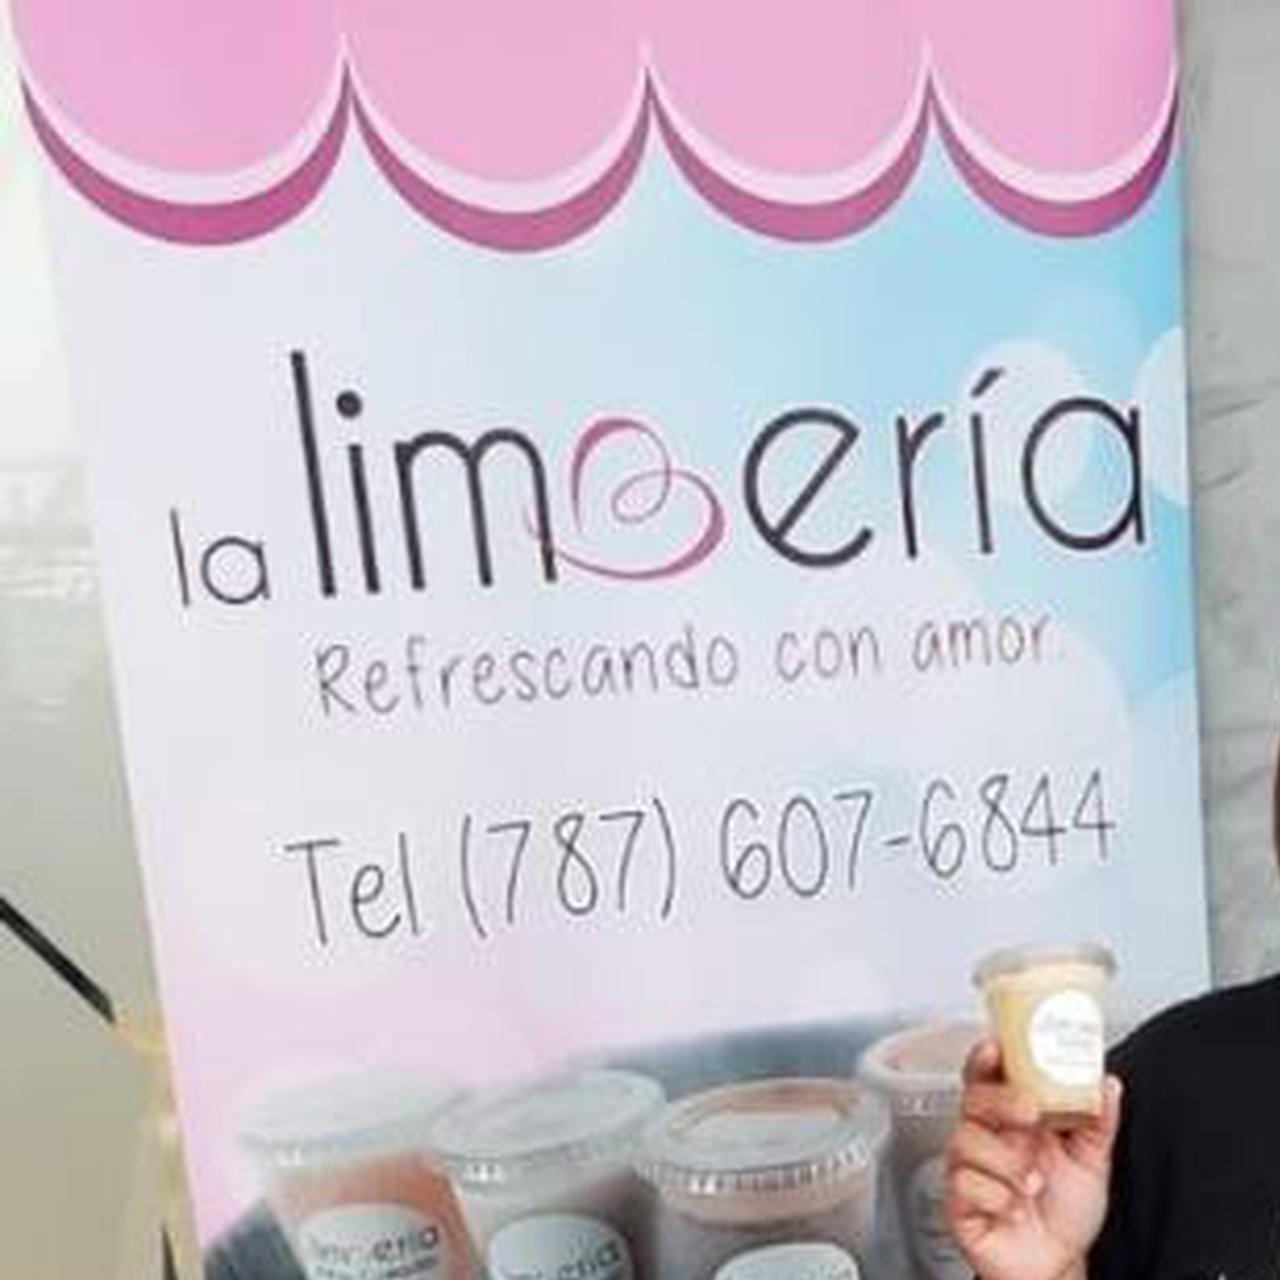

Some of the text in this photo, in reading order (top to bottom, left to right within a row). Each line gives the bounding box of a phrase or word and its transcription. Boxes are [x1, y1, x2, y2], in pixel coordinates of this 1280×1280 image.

[169, 508, 272, 608] la
[315, 624, 739, 718] Refrescando
[774, 621, 882, 684] con
[284, 768, 1118, 944] Tel (787) 607-6844
